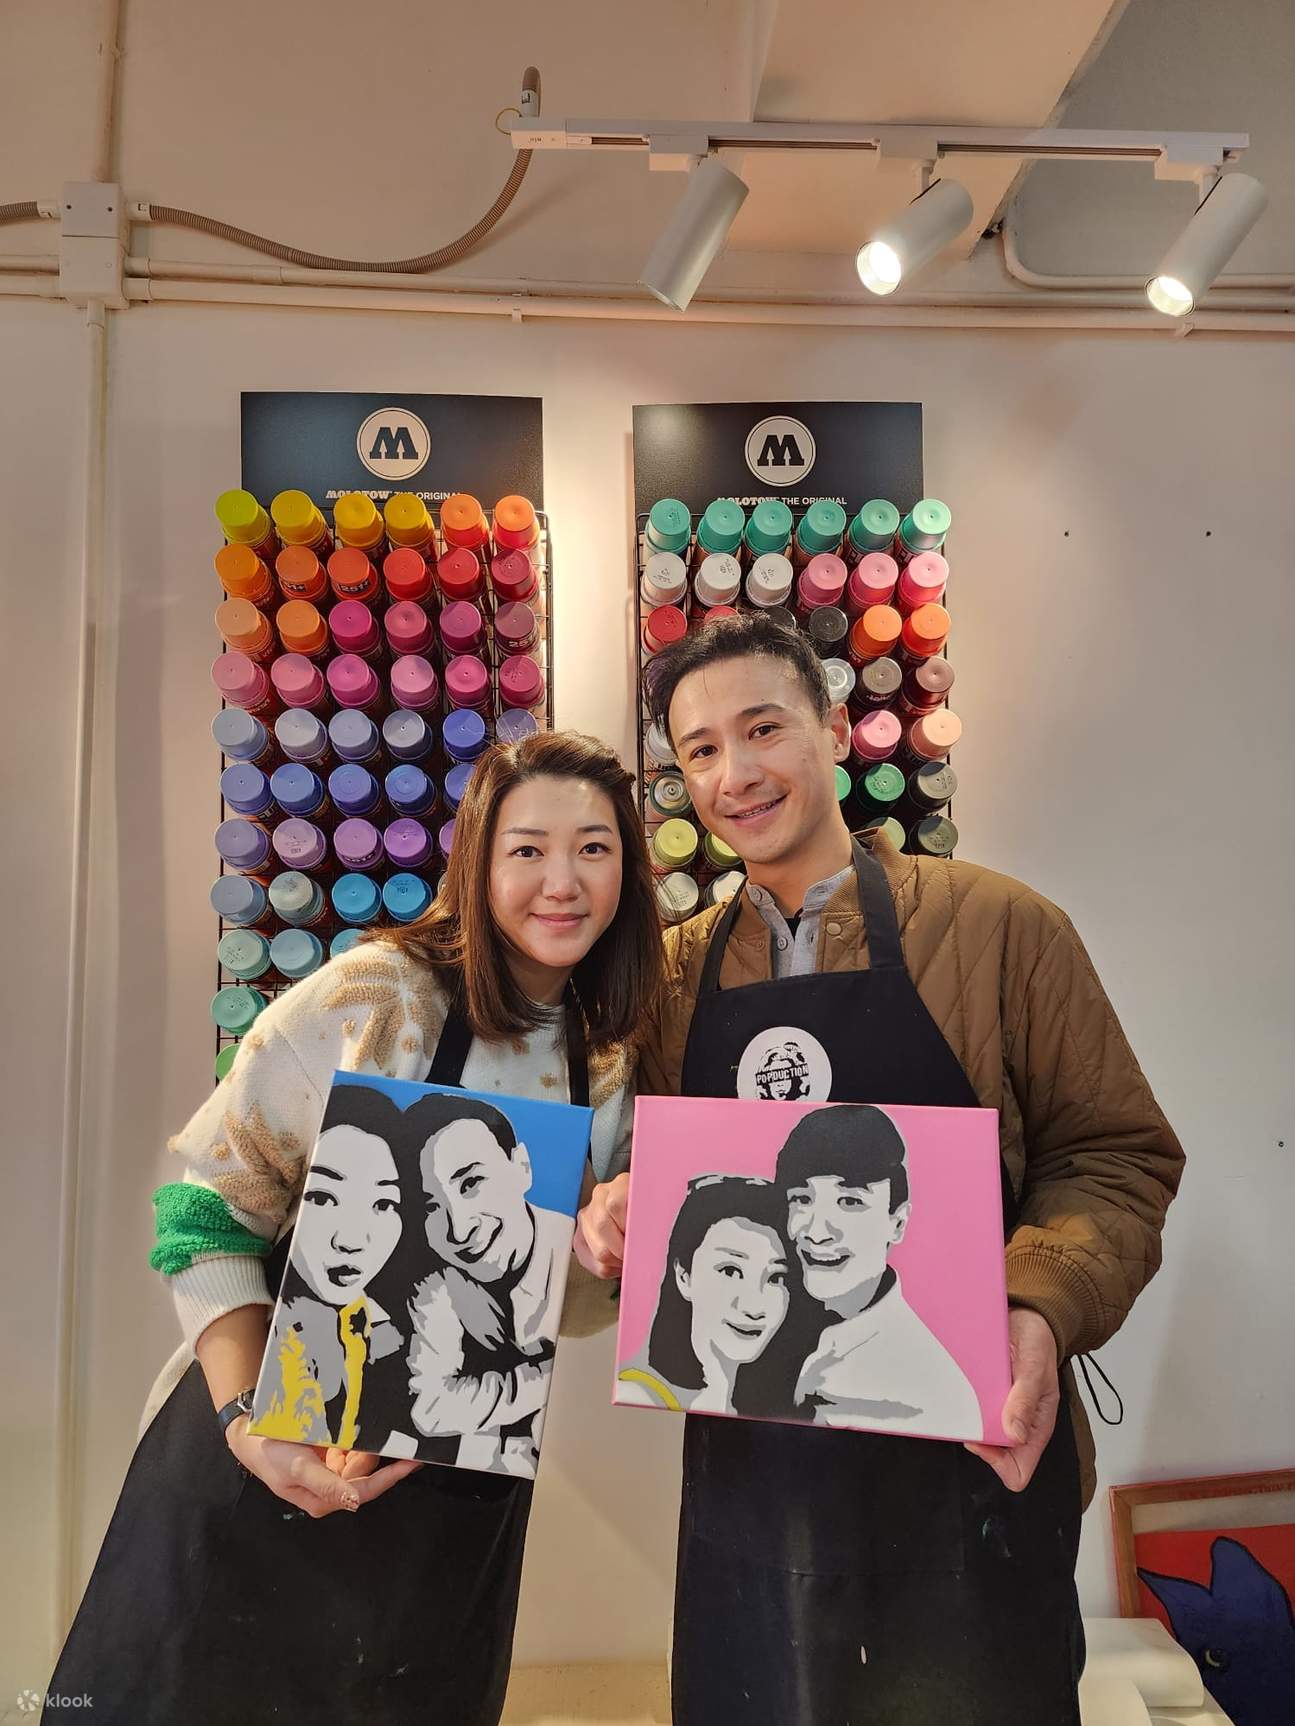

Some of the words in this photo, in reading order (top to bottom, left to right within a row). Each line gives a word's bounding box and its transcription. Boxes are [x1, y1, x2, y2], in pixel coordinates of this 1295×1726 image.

[369, 426, 419, 460] M
[757, 434, 805, 467] M
[416, 491, 461, 500] ORIGIN
[781, 497, 800, 505] THE
[756, 1064, 809, 1084] POPDUCTION
